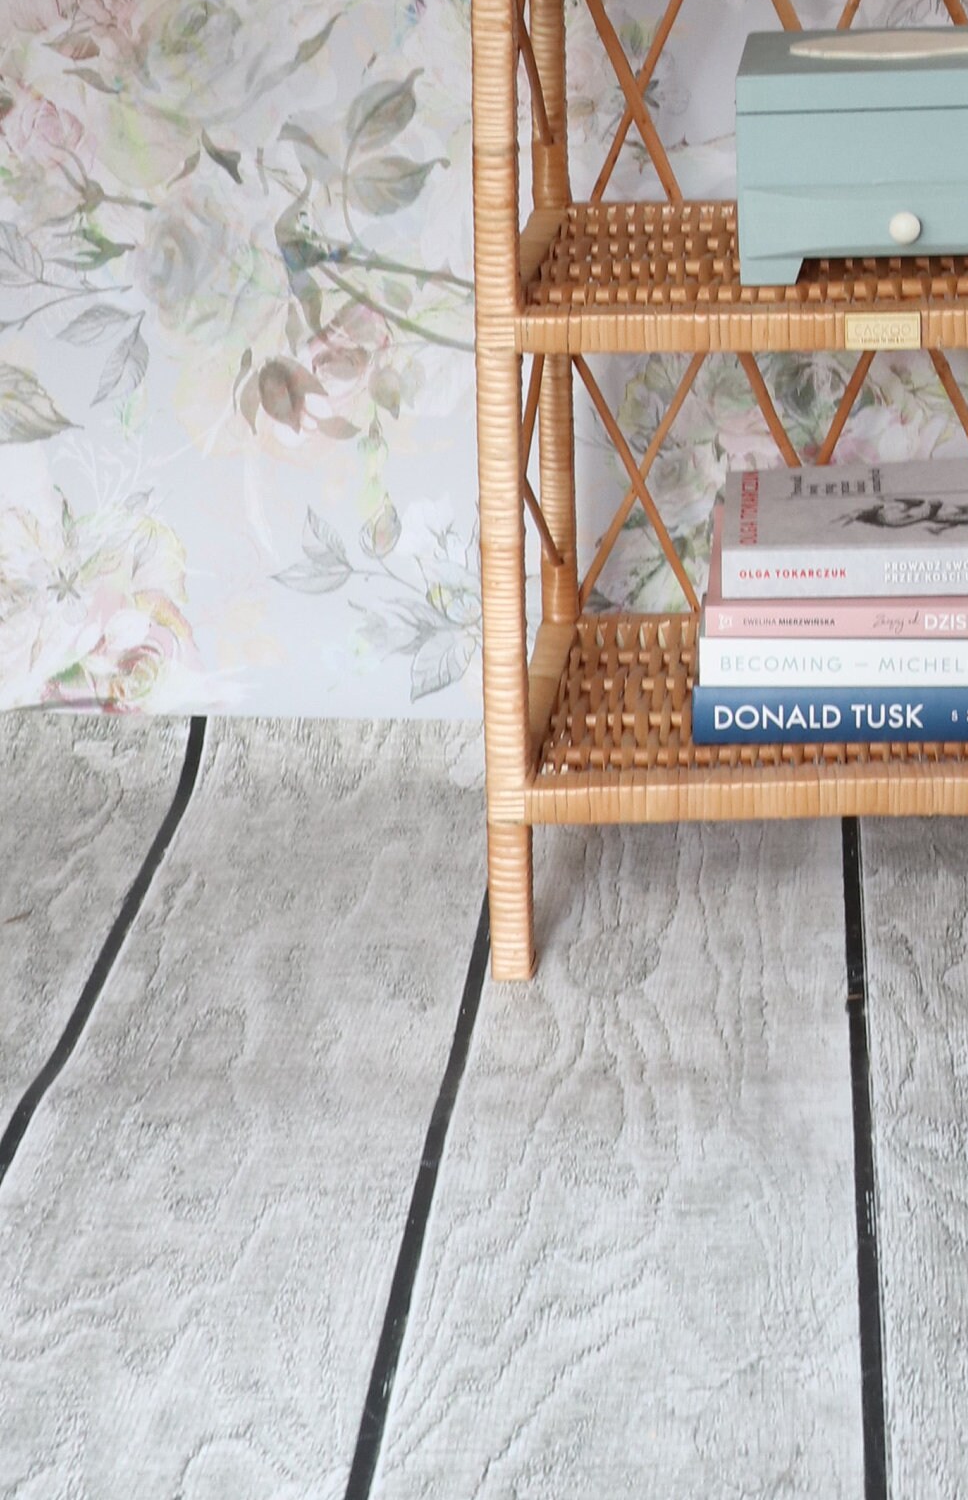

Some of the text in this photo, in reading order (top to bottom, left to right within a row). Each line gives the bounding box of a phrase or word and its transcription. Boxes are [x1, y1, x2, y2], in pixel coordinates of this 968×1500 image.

[738, 567, 848, 580] OLGA TOKARCZUK
[743, 616, 836, 627] EWELINA MIERZWIŃSKA
[720, 655, 843, 673] BECOMING
[713, 703, 842, 730] DONALD
[850, 703, 924, 730] TUSK
